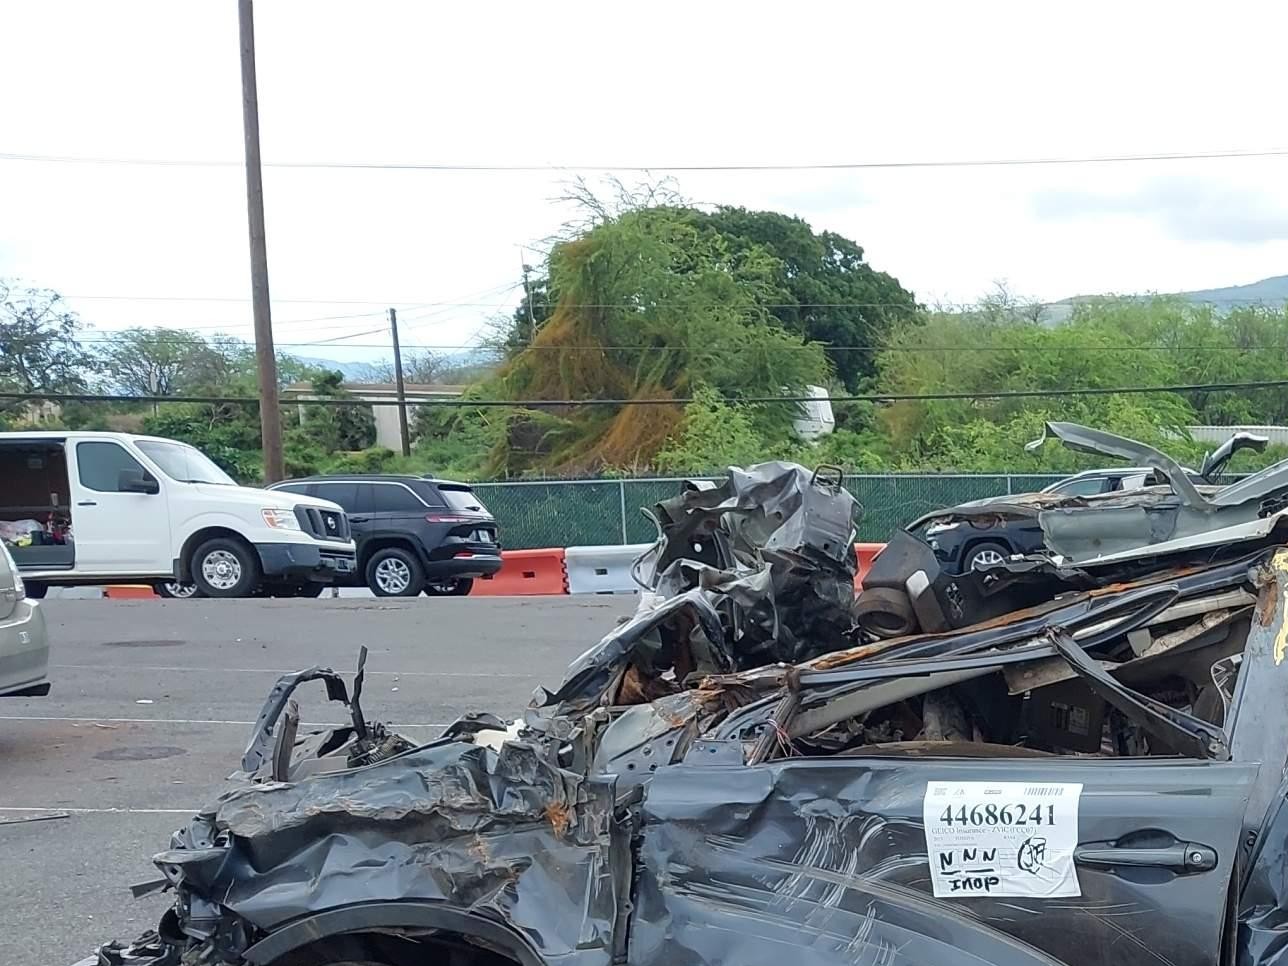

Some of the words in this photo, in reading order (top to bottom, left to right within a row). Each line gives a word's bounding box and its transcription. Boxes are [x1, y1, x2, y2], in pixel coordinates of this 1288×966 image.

[940, 803, 1056, 826] 44686241
[956, 826, 986, 834] Insurance
[940, 851, 953, 871] N
[963, 847, 977, 862] N
[982, 847, 996, 862] N
